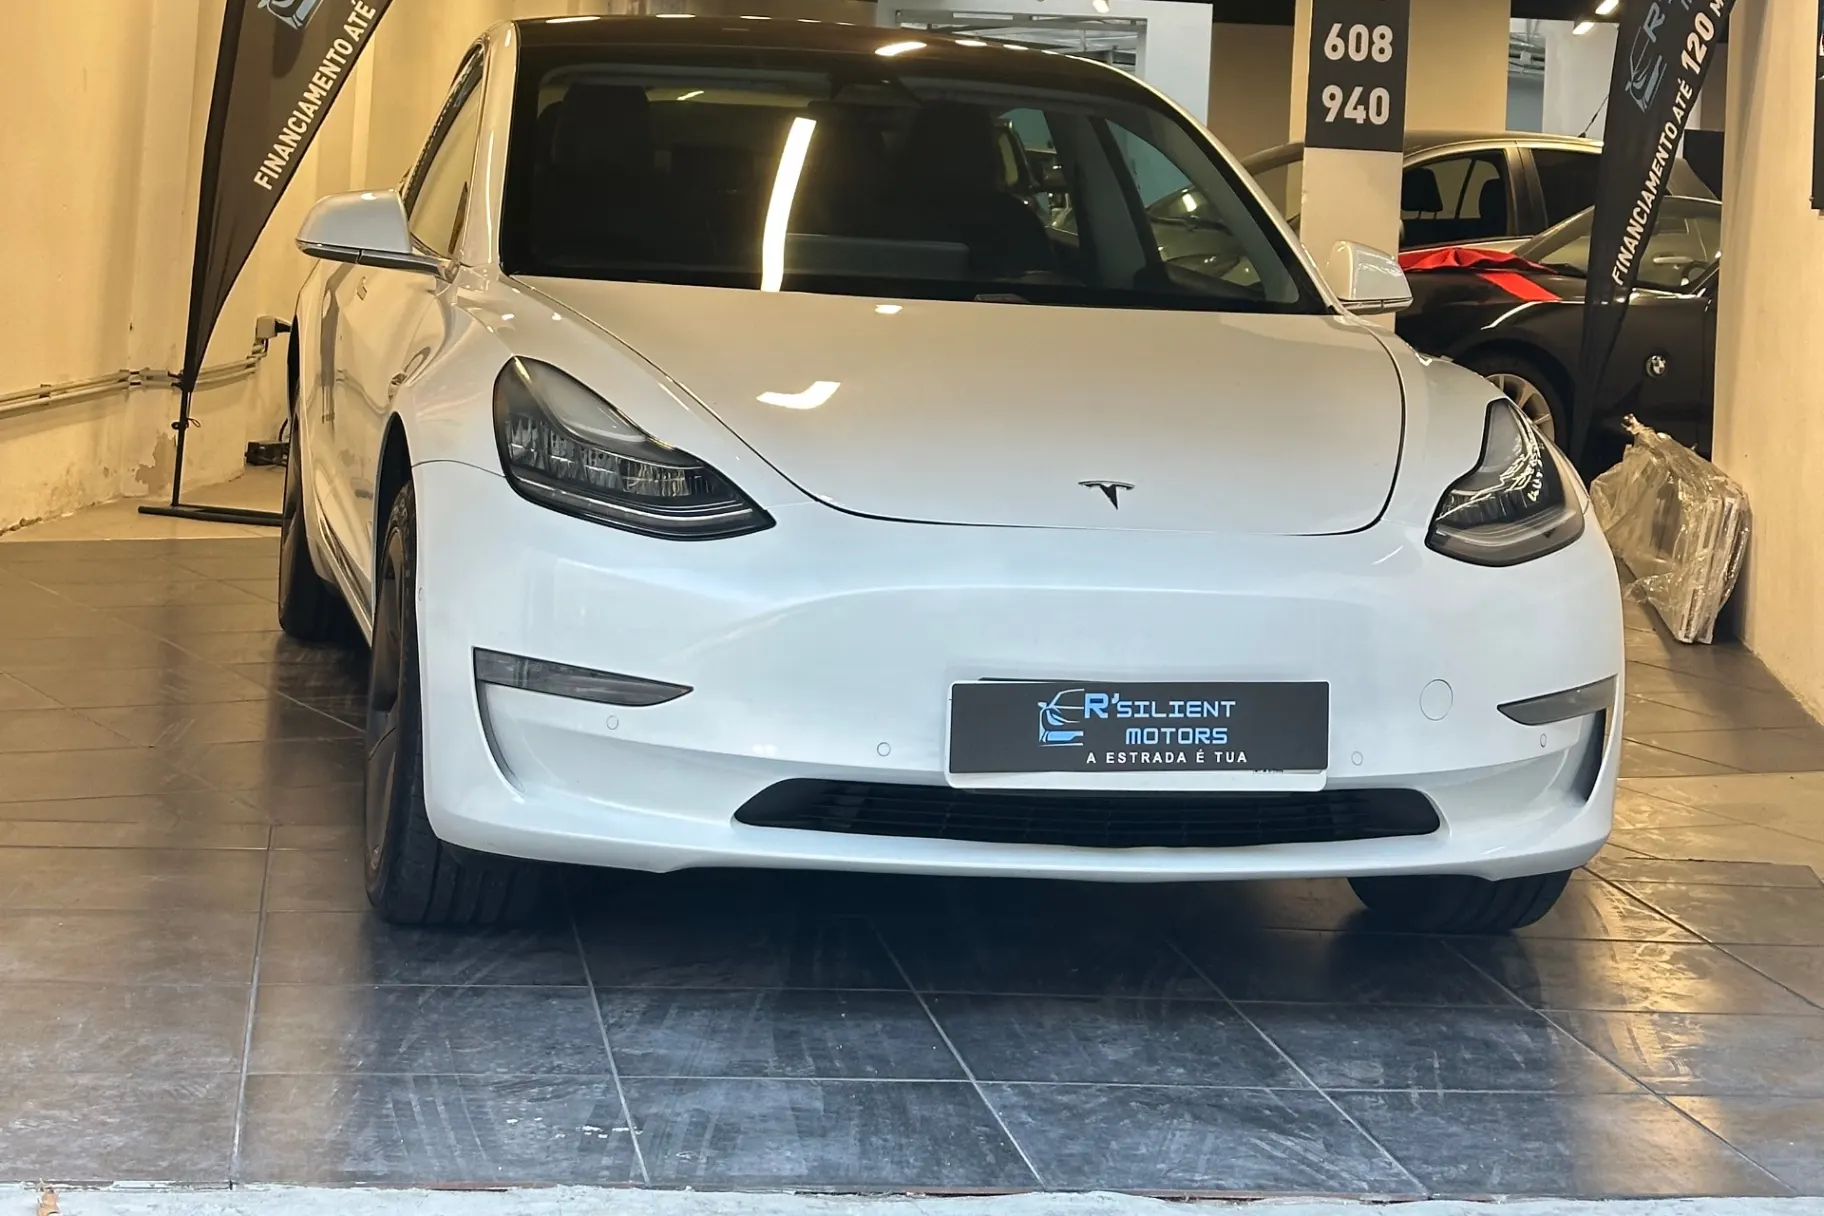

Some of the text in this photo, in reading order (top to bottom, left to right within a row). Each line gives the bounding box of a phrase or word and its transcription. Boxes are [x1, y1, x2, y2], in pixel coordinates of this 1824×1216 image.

[1323, 22, 1393, 63] 608
[1681, 12, 1715, 75] 120
[253, 37, 354, 191] FINANCIAMENTO
[1321, 84, 1390, 125] 940
[1672, 77, 1694, 125] ATÉ
[1611, 121, 1679, 286] FINANCIAMENTO
[1086, 748, 1248, 764] A ESTRADA É TUA
[1126, 727, 1228, 745] MOTORS
